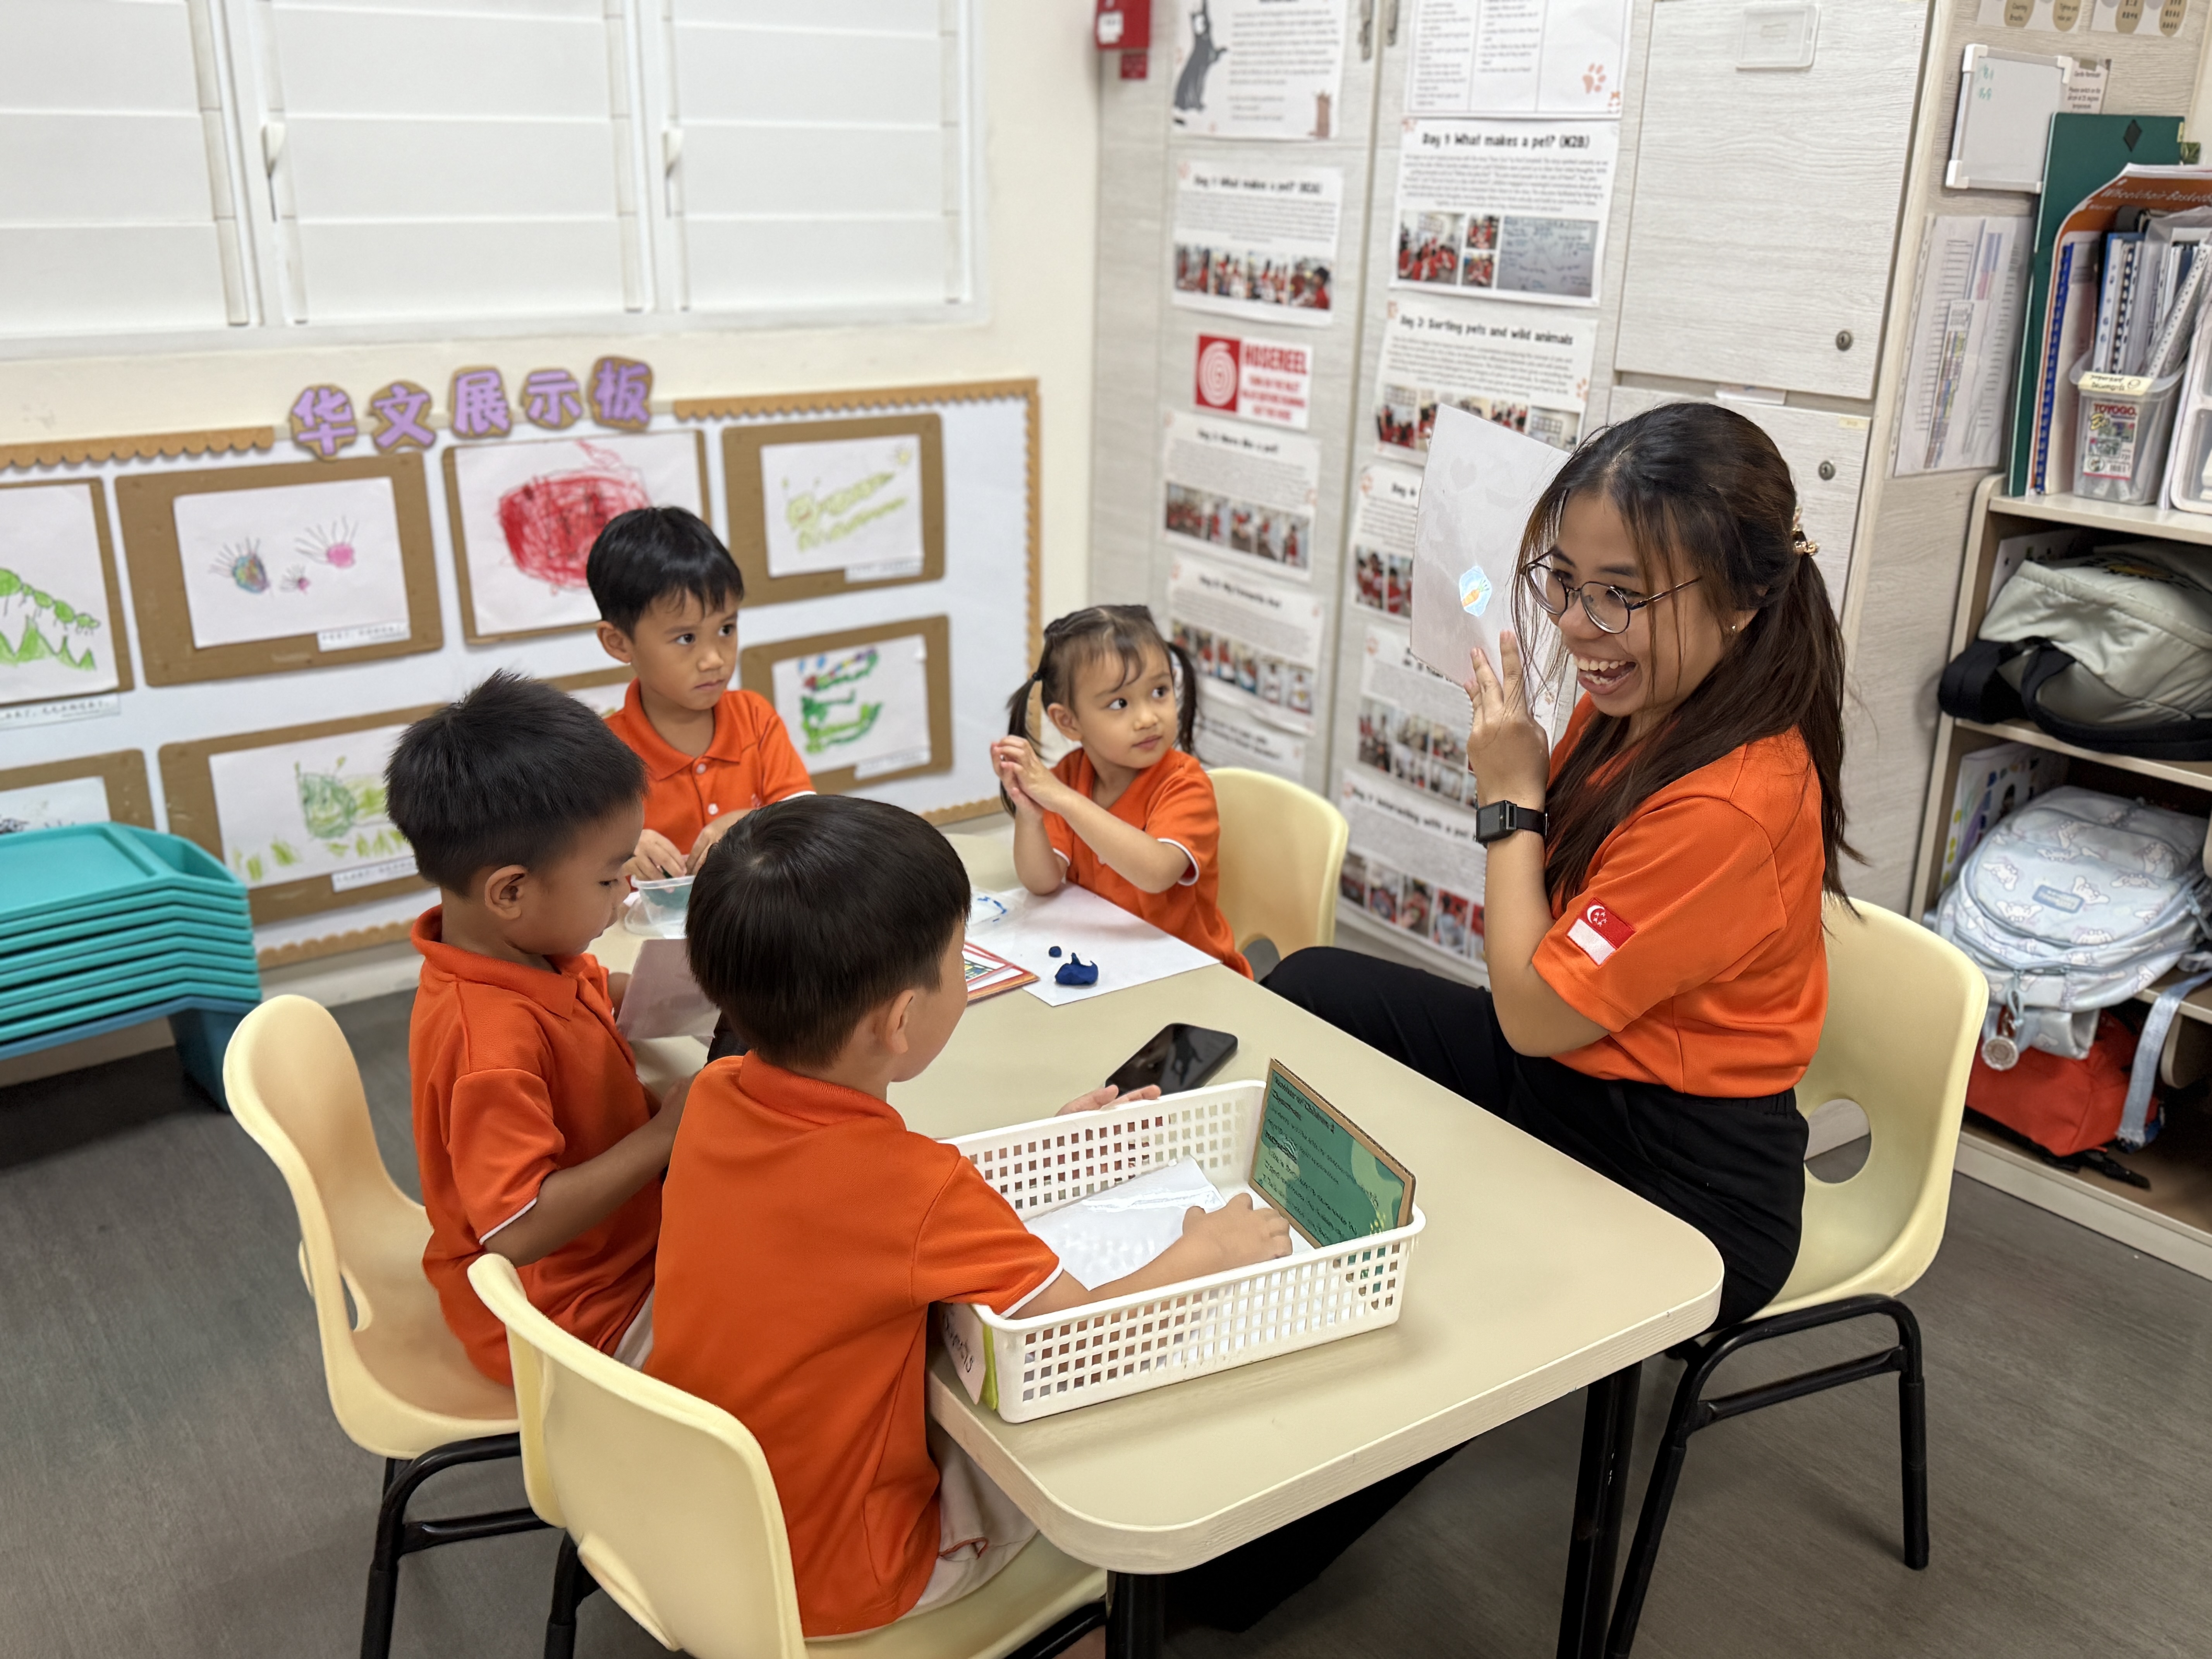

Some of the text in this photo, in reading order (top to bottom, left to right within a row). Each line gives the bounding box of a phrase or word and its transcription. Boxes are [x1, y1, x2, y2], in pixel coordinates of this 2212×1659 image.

[1422, 132, 1440, 148] Day
[1455, 132, 1481, 146] What
[1485, 133, 1518, 147] makes
[1522, 138, 1527, 147] a
[1531, 134, 1556, 150] pet?
[1400, 314, 1414, 329] Day
[1428, 318, 1462, 335] Sorting
[1466, 323, 1486, 336] pets
[1490, 325, 1508, 338] and
[1511, 327, 1531, 340] wild
[1534, 330, 1573, 346] animals
[293, 358, 651, 456] 华文展示板
